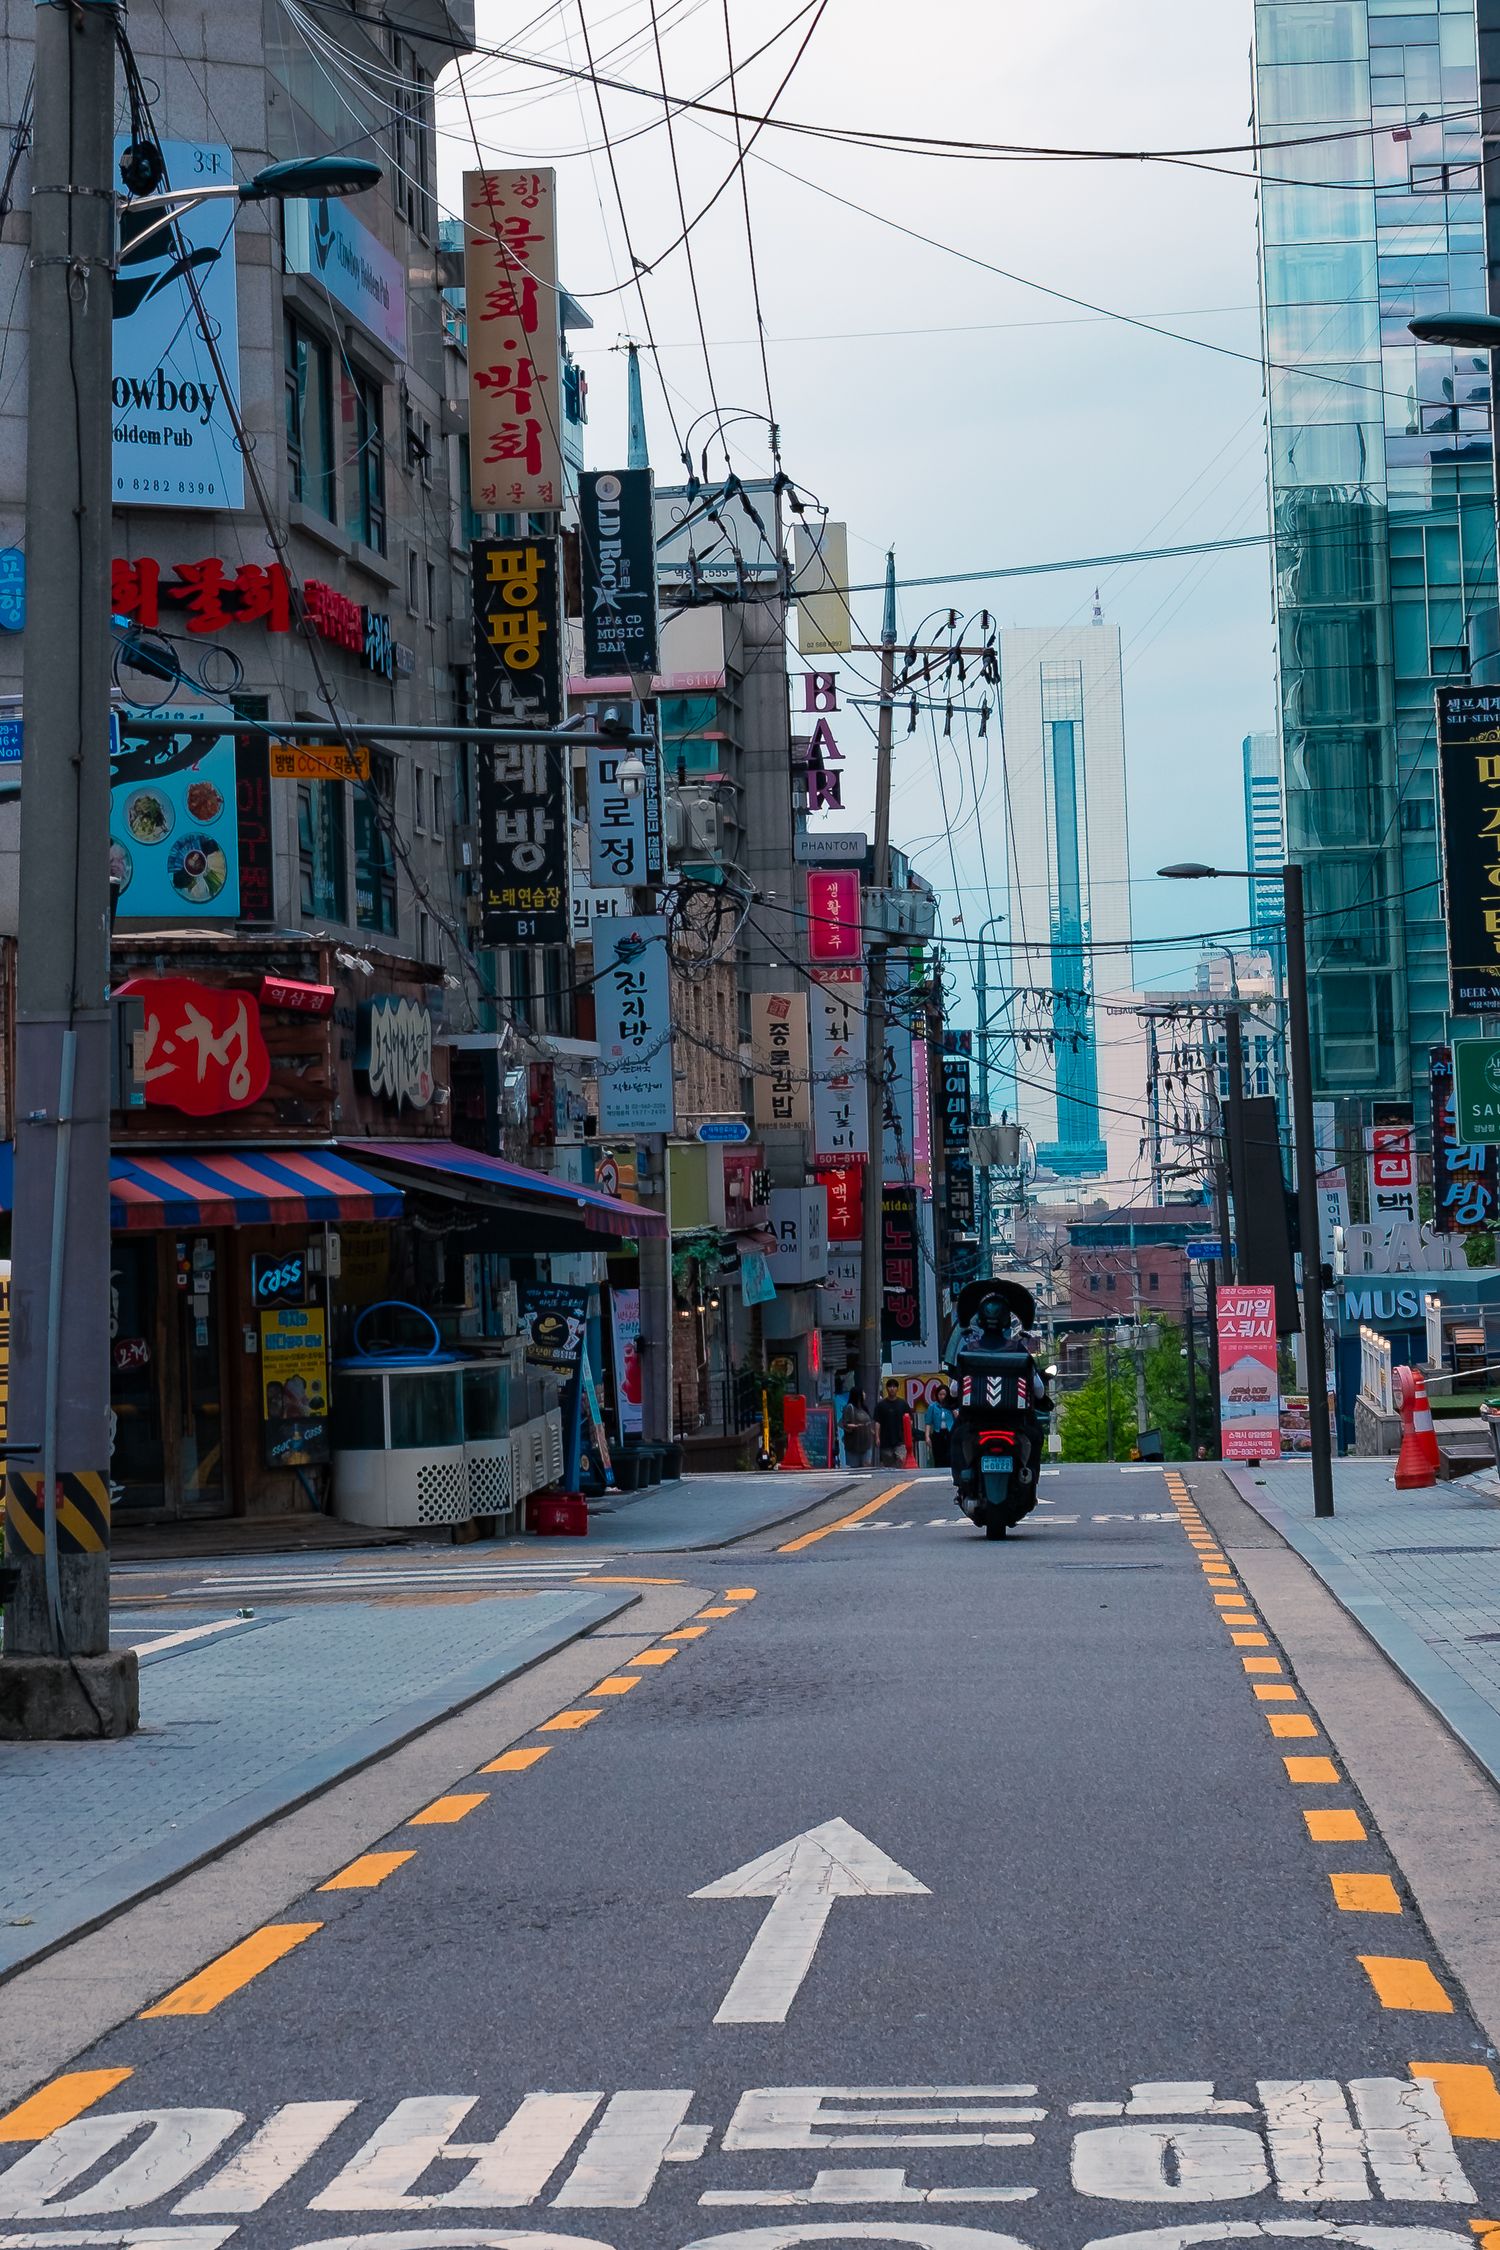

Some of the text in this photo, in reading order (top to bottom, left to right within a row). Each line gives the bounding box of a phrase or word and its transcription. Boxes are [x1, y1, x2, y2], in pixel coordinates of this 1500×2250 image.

[471, 174, 546, 208] 포항
[112, 368, 219, 425] owboy
[112, 426, 193, 447] oldem Pub
[133, 478, 215, 495] 8282 8390
[480, 481, 553, 504] 전문점
[485, 547, 546, 670] 팡팡
[626, 615, 642, 625] CD
[597, 627, 644, 639] MUSIC
[597, 641, 625, 652] BAR
[804, 671, 845, 810] BAR
[275, 753, 295, 772] 방범
[297, 756, 331, 773] CCTV
[490, 680, 555, 872] 노래방
[801, 840, 858, 851] PHANTOM
[488, 886, 561, 909] 노래연습장
[516, 919, 536, 935] B1
[821, 969, 853, 982] 24시
[271, 988, 324, 1009] 역삼점
[258, 1258, 302, 1297] Cass
[884, 1219, 917, 1329] 노래방
[1218, 1299, 1271, 1318] 스마일
[1218, 1319, 1273, 1338] 스쿼시
